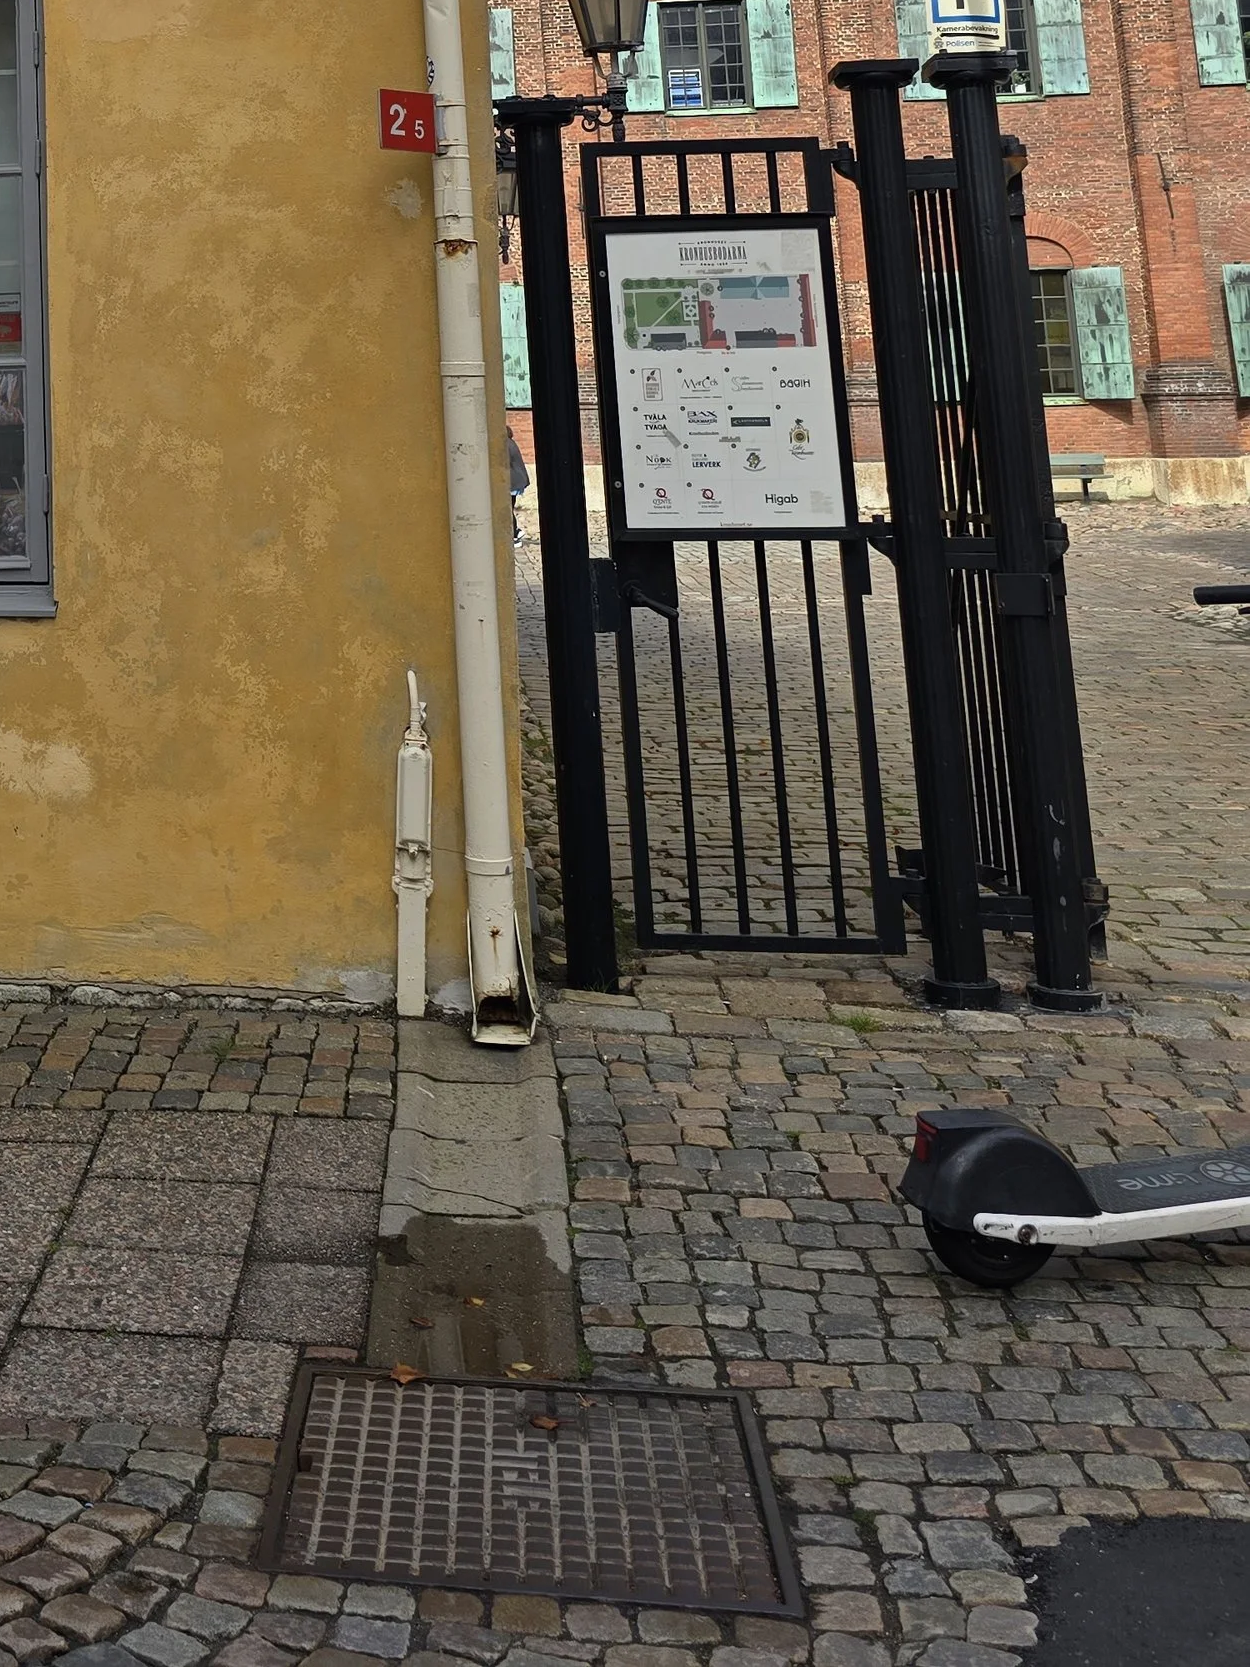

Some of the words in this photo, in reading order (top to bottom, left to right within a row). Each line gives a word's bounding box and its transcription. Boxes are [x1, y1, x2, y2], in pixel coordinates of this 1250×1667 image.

[936, 25, 999, 34] Kamerabevakning
[678, 246, 747, 261] KRONHUSBODARNA
[765, 493, 799, 506] Higab
[1116, 1171, 1200, 1191] Lime
